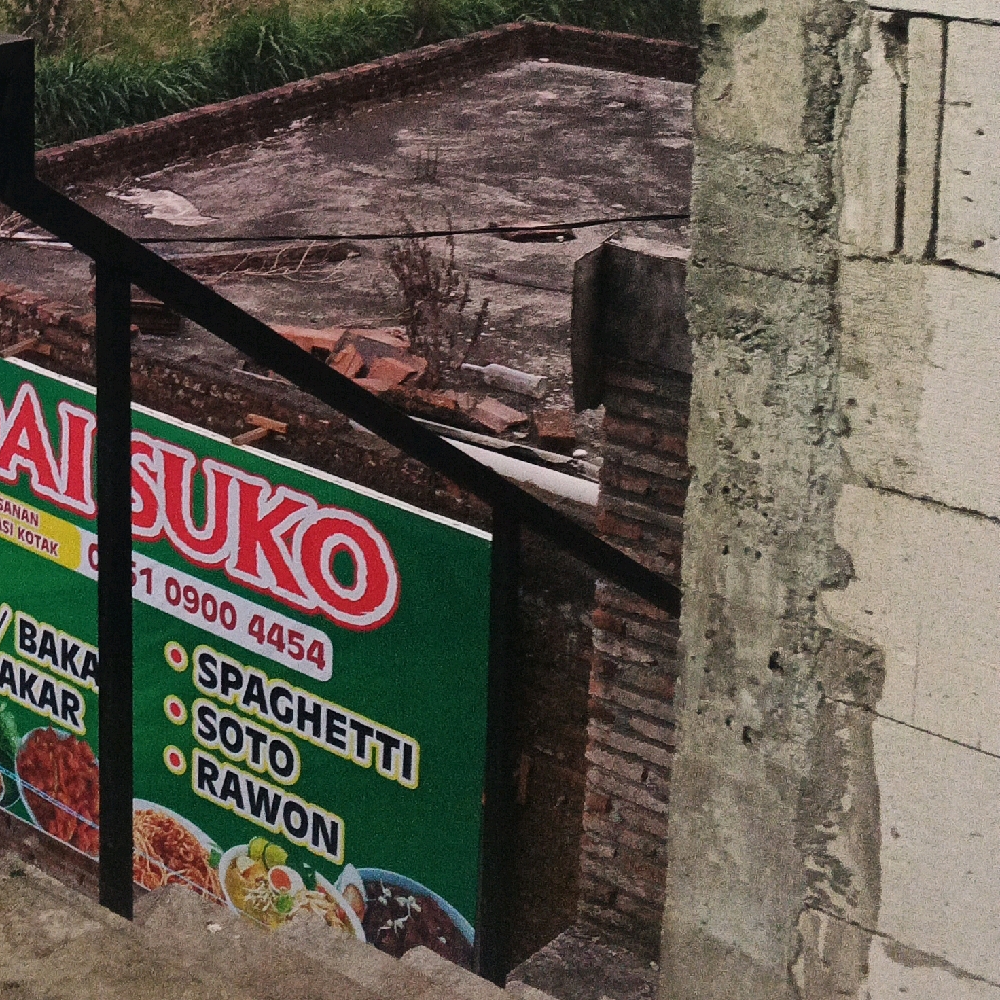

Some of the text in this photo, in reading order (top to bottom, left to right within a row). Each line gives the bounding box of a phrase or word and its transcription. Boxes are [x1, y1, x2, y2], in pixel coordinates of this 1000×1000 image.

[17, 525, 59, 557] KOTAK
[131, 431, 398, 626] SUKO
[18, 617, 99, 686] BAKA
[165, 576, 237, 631] 0900
[247, 614, 326, 671] 4454
[197, 652, 413, 781] SPAGHETTI
[197, 704, 295, 778] SOTO
[197, 756, 339, 857] RAWON
